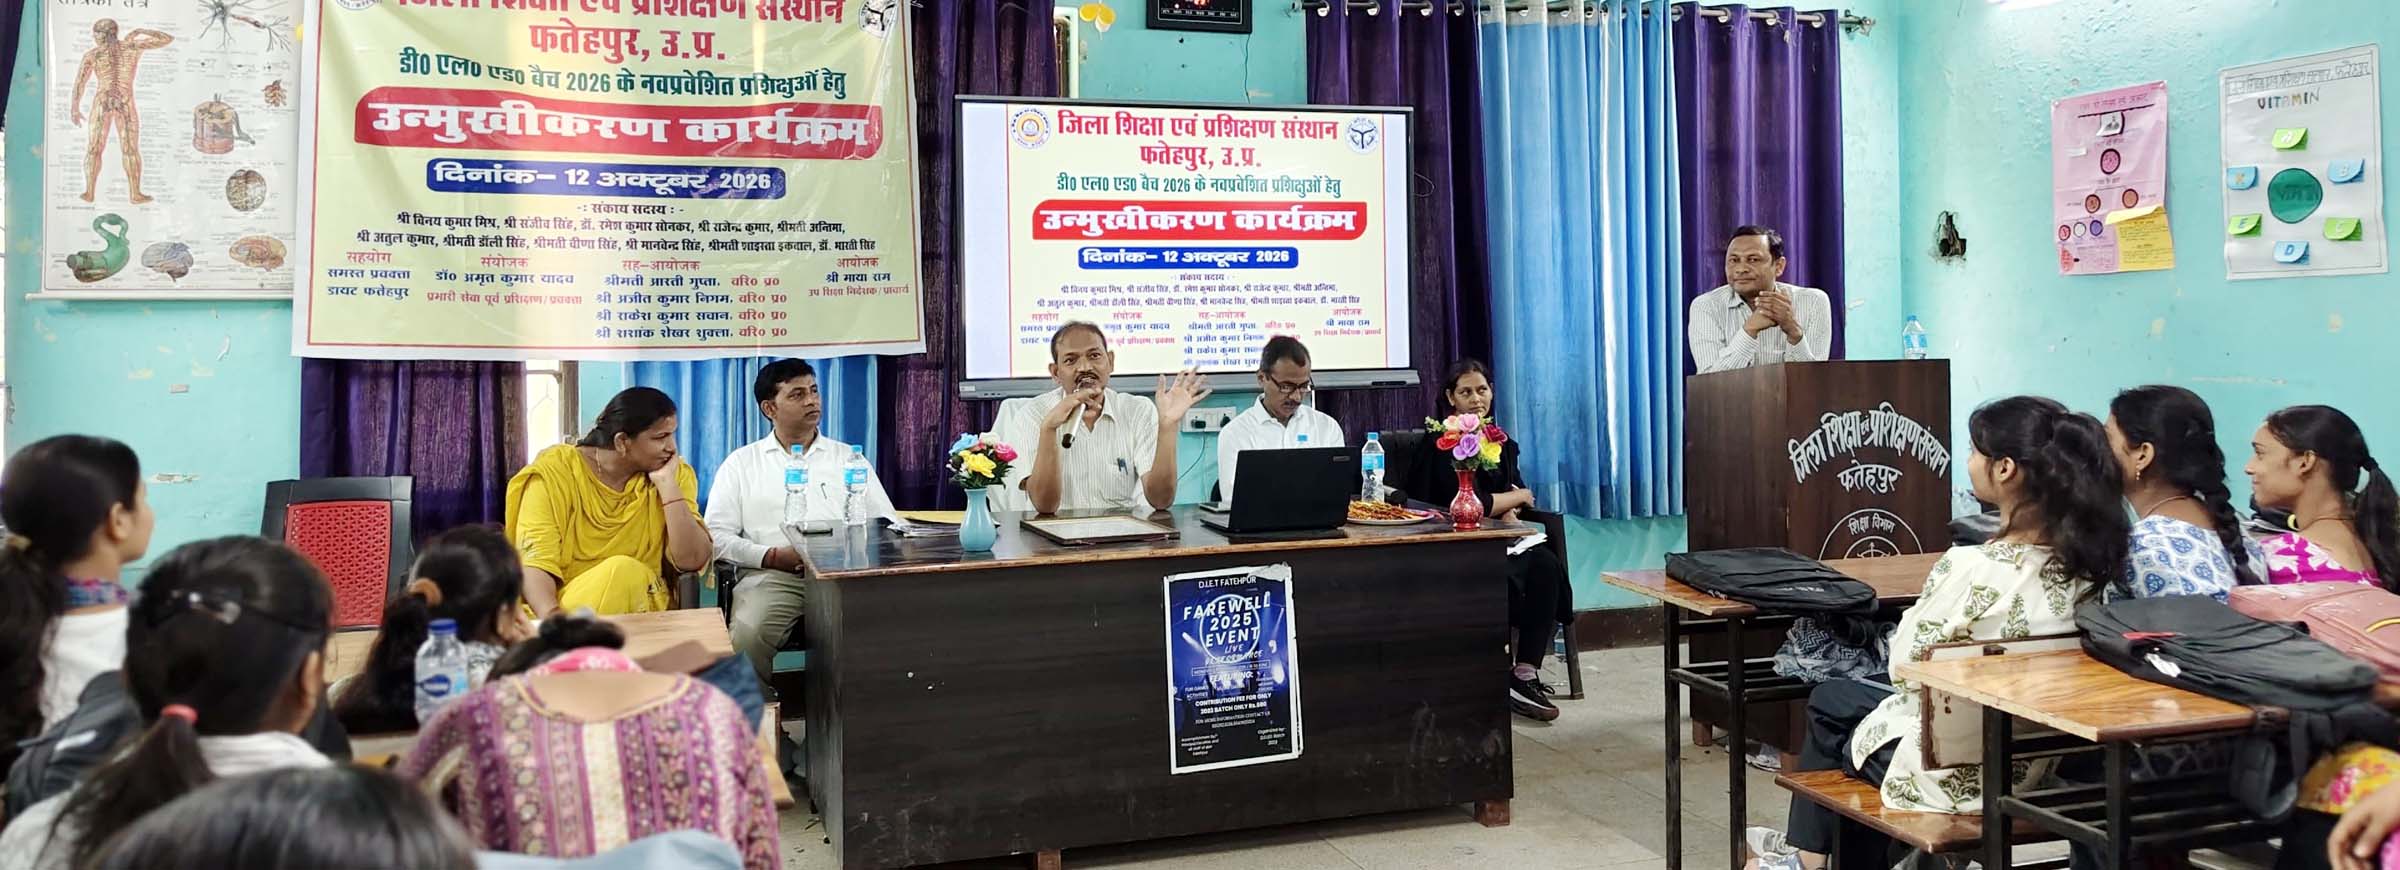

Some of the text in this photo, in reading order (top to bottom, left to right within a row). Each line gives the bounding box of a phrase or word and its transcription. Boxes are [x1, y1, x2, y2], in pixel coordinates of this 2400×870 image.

[529, 18, 650, 64] फतेहपुर,
[528, 64, 561, 88] बैच
[566, 72, 610, 93] 2026
[616, 68, 635, 93] के
[641, 70, 734, 96] नवप्रवेशित
[740, 69, 820, 99] प्रशिक्षुओं
[822, 68, 846, 100] हेतु
[368, 100, 869, 146] उन्मुखीकरण कार्यक्रम
[1058, 109, 1110, 135] जिला
[1114, 111, 1164, 136] शिक्षा
[1170, 113, 1198, 137] एवं
[1203, 114, 1276, 139] प्रशिक्षण
[1281, 116, 1339, 140] संस्थान
[1140, 140, 1214, 171] फतेहपुर,
[564, 170, 589, 185] 12
[596, 172, 709, 195] अक्टूबर
[720, 173, 771, 189] 2026
[1142, 173, 1159, 192] बैच
[1164, 178, 1191, 192] 2026
[1195, 174, 1207, 192] के
[1211, 174, 1268, 193] नवप्रवेशित
[1272, 175, 1322, 198] प्रशिक्षुओं
[1325, 176, 1342, 198] हेतु
[591, 201, 666, 214] संकाय सदस्य
[397, 212, 410, 224] श्री
[413, 213, 441, 226] विनय
[444, 217, 472, 230] कुमार
[504, 216, 517, 228] श्री
[520, 216, 550, 229] संजीव
[599, 219, 621, 230] रमेश
[626, 221, 651, 234] कुमार
[656, 219, 694, 233] सोनकर,
[698, 220, 710, 232] श्री
[745, 222, 774, 235] कुमार,
[777, 220, 806, 233] श्रीमती
[1040, 204, 1357, 237] उन्मुखीकरण कार्यक्रम
[357, 230, 370, 242] श्री
[374, 232, 402, 245] अतुल
[406, 234, 439, 248] कुमार,
[443, 234, 475, 247] श्रीमती
[479, 235, 503, 248] डॉली
[534, 236, 566, 249] श्रीमती
[570, 236, 595, 249] वीणा
[626, 238, 637, 250] श्री
[641, 239, 679, 251] मानवेन्द्र
[708, 238, 738, 251] श्रीमती
[834, 240, 857, 251] भारती
[347, 249, 392, 264] सहयोग
[2284, 244, 2294, 256] D
[481, 254, 528, 267] संयोजक
[837, 255, 879, 268] आयोजक
[1163, 251, 1178, 263] 12
[1182, 251, 1251, 268] अक्टूबर
[1256, 250, 1290, 263] 2026
[328, 269, 365, 279] समस्त
[464, 272, 495, 286] अमृत
[500, 274, 534, 287] कुमार
[541, 275, 574, 284] यादव
[604, 275, 644, 287] श्रीमती
[650, 276, 683, 287] आरती
[826, 272, 891, 283] श्री माया राम
[328, 284, 409, 300] डायट फतेहपुर
[427, 290, 456, 301] प्रभारी
[618, 292, 651, 304] अजीत
[657, 294, 689, 307] कुमार
[617, 309, 651, 321] राकेश
[657, 312, 689, 324] कुमार
[617, 326, 654, 338] शशांक
[661, 326, 689, 338] शेखर
[1788, 429, 1827, 483] जिला
[1820, 411, 1862, 457] शिक्षा
[1837, 459, 1903, 494] फतेहपुर
[1848, 512, 1895, 535] शिक्षा विभाग
[1220, 576, 1257, 587] FATEHPUR
[1184, 591, 1271, 621] FAREWELL
[1210, 612, 1252, 632] 2025
[1205, 627, 1259, 648] EVENT
[1224, 644, 1244, 654] LIVE
[1195, 696, 1235, 707] CONTRIBUTION
[1246, 694, 1257, 702] FOR
[1257, 692, 1272, 700] ONLY
[1214, 705, 1233, 713] BATCH
